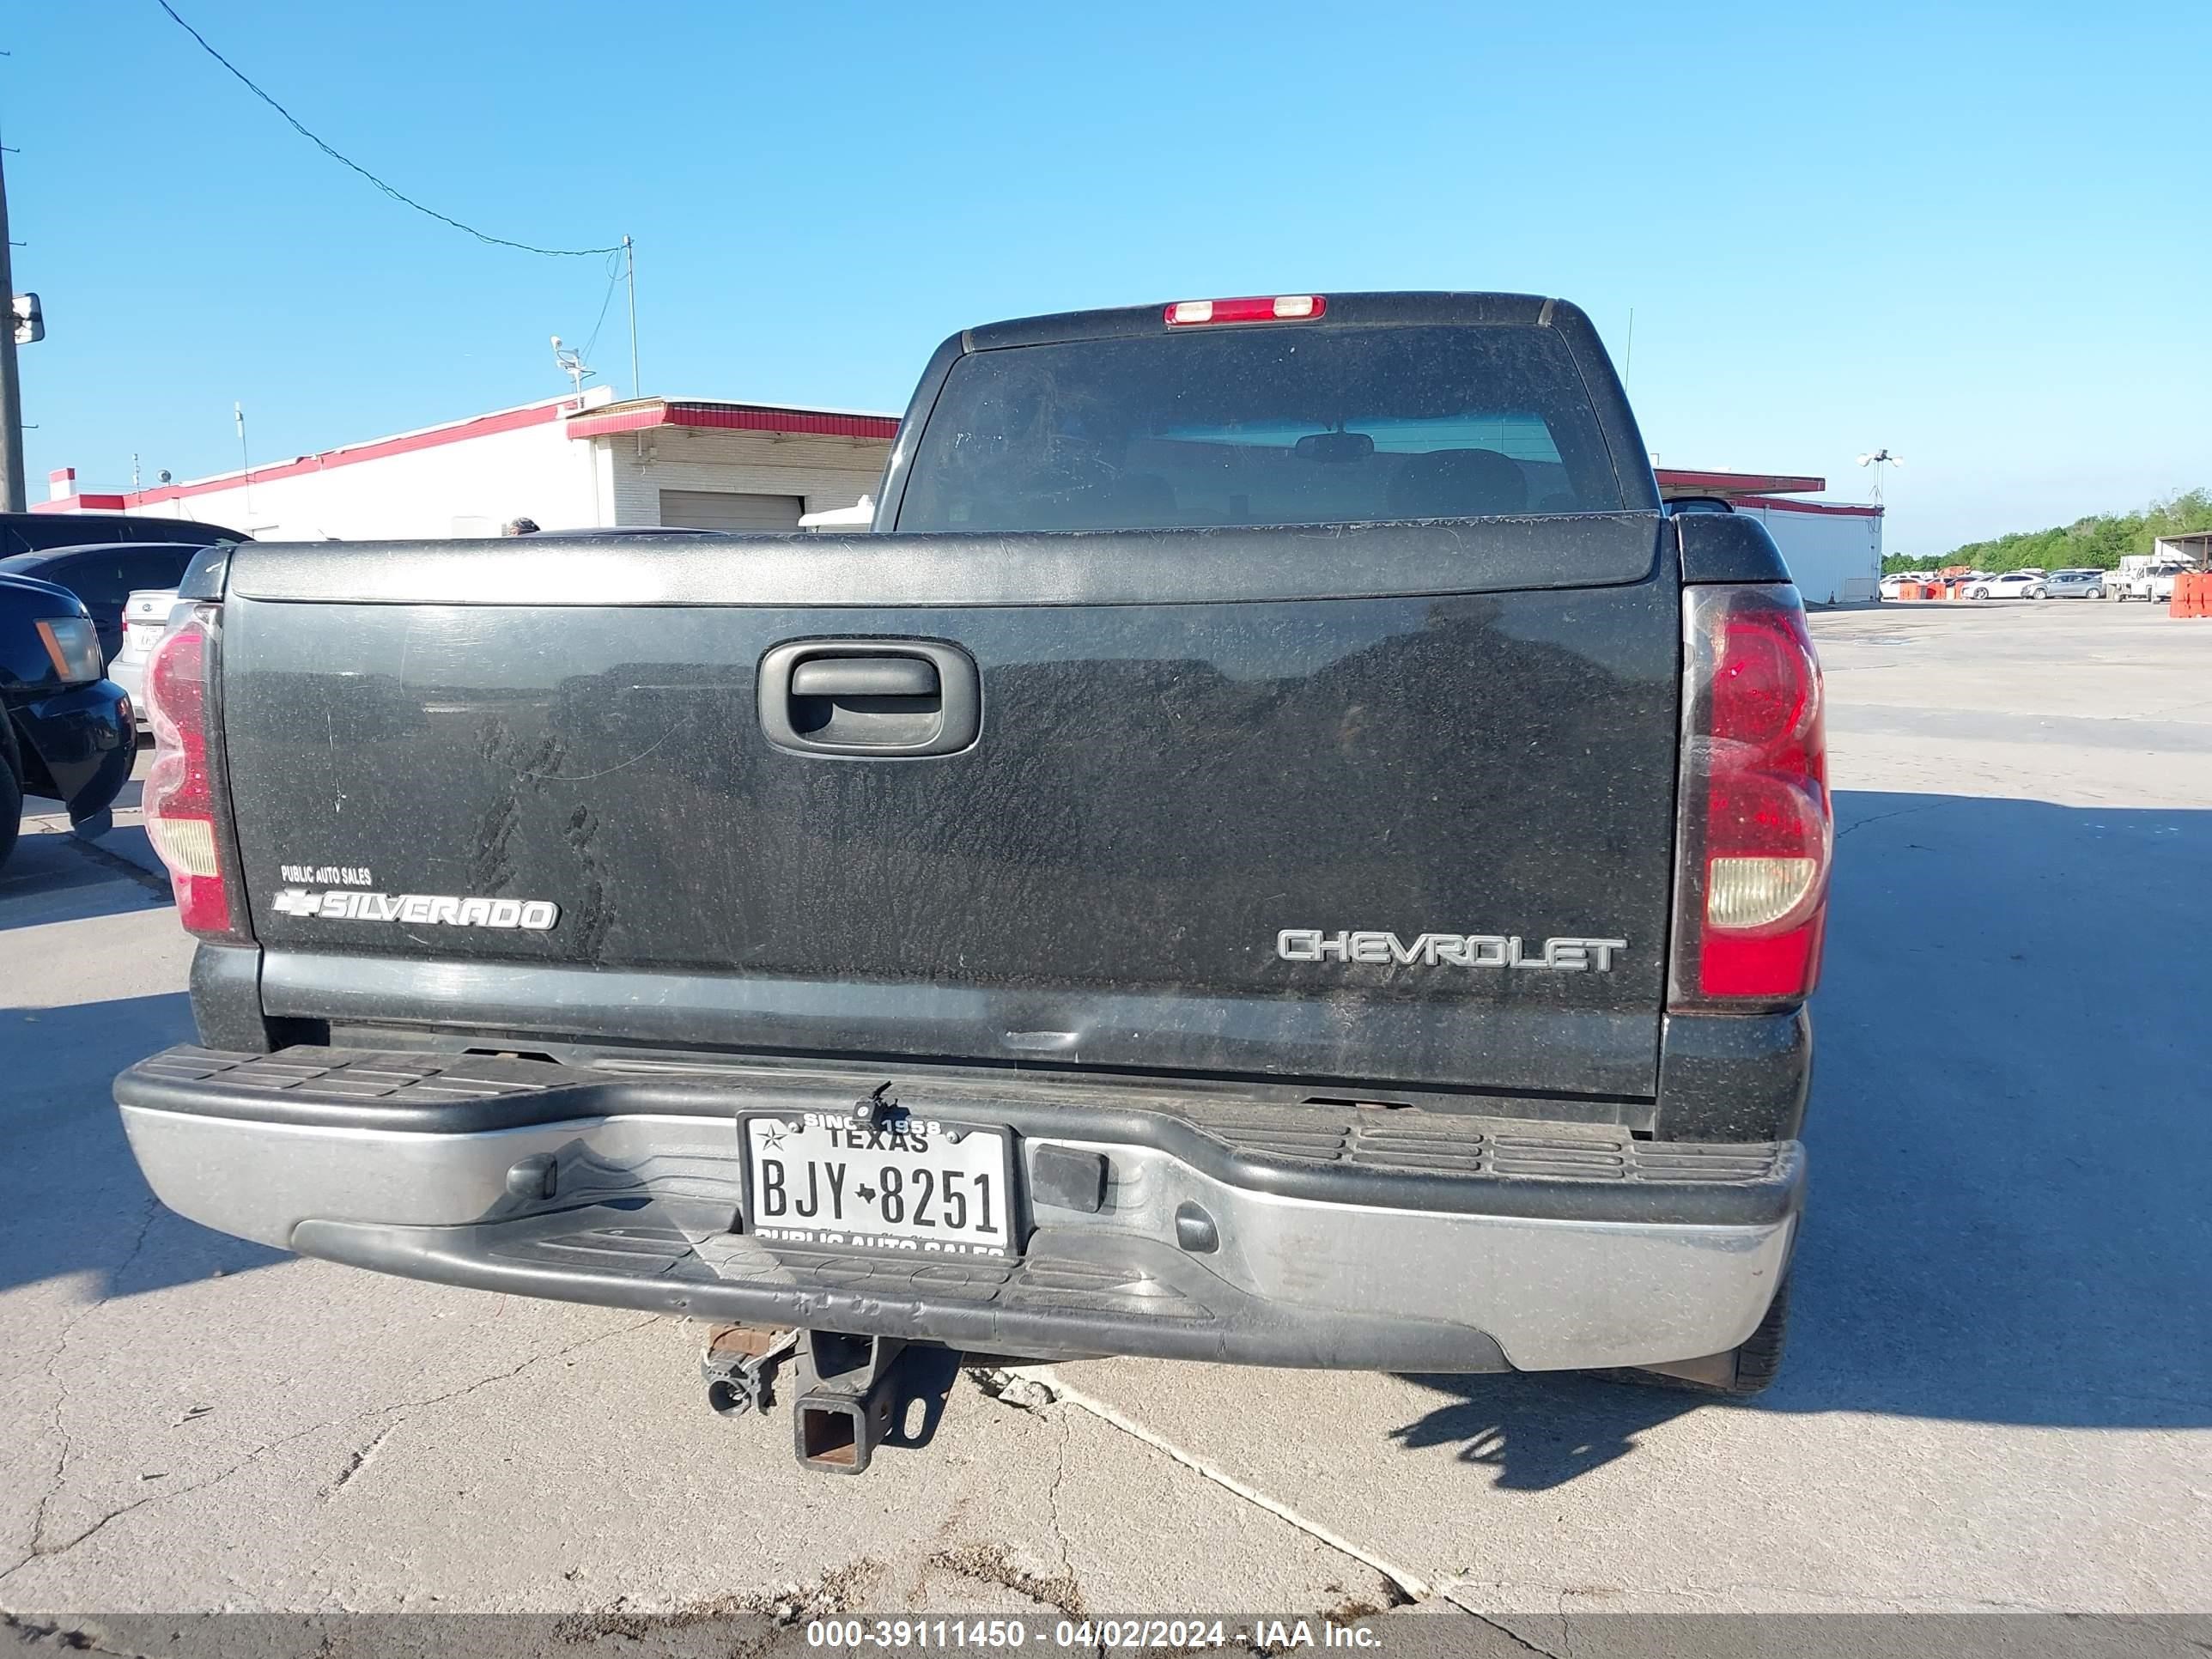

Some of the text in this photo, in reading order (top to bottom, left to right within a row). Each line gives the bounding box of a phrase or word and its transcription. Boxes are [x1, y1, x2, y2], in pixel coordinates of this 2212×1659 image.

[281, 865, 372, 885] PUBLIC AUTO SALES
[319, 890, 561, 931] SILVERADO
[1277, 929, 1629, 972] CHEVROLET
[804, 1113, 941, 1135] SINC 1958
[830, 1127, 929, 1153] TEXAS
[762, 1158, 998, 1234] BJY 8251
